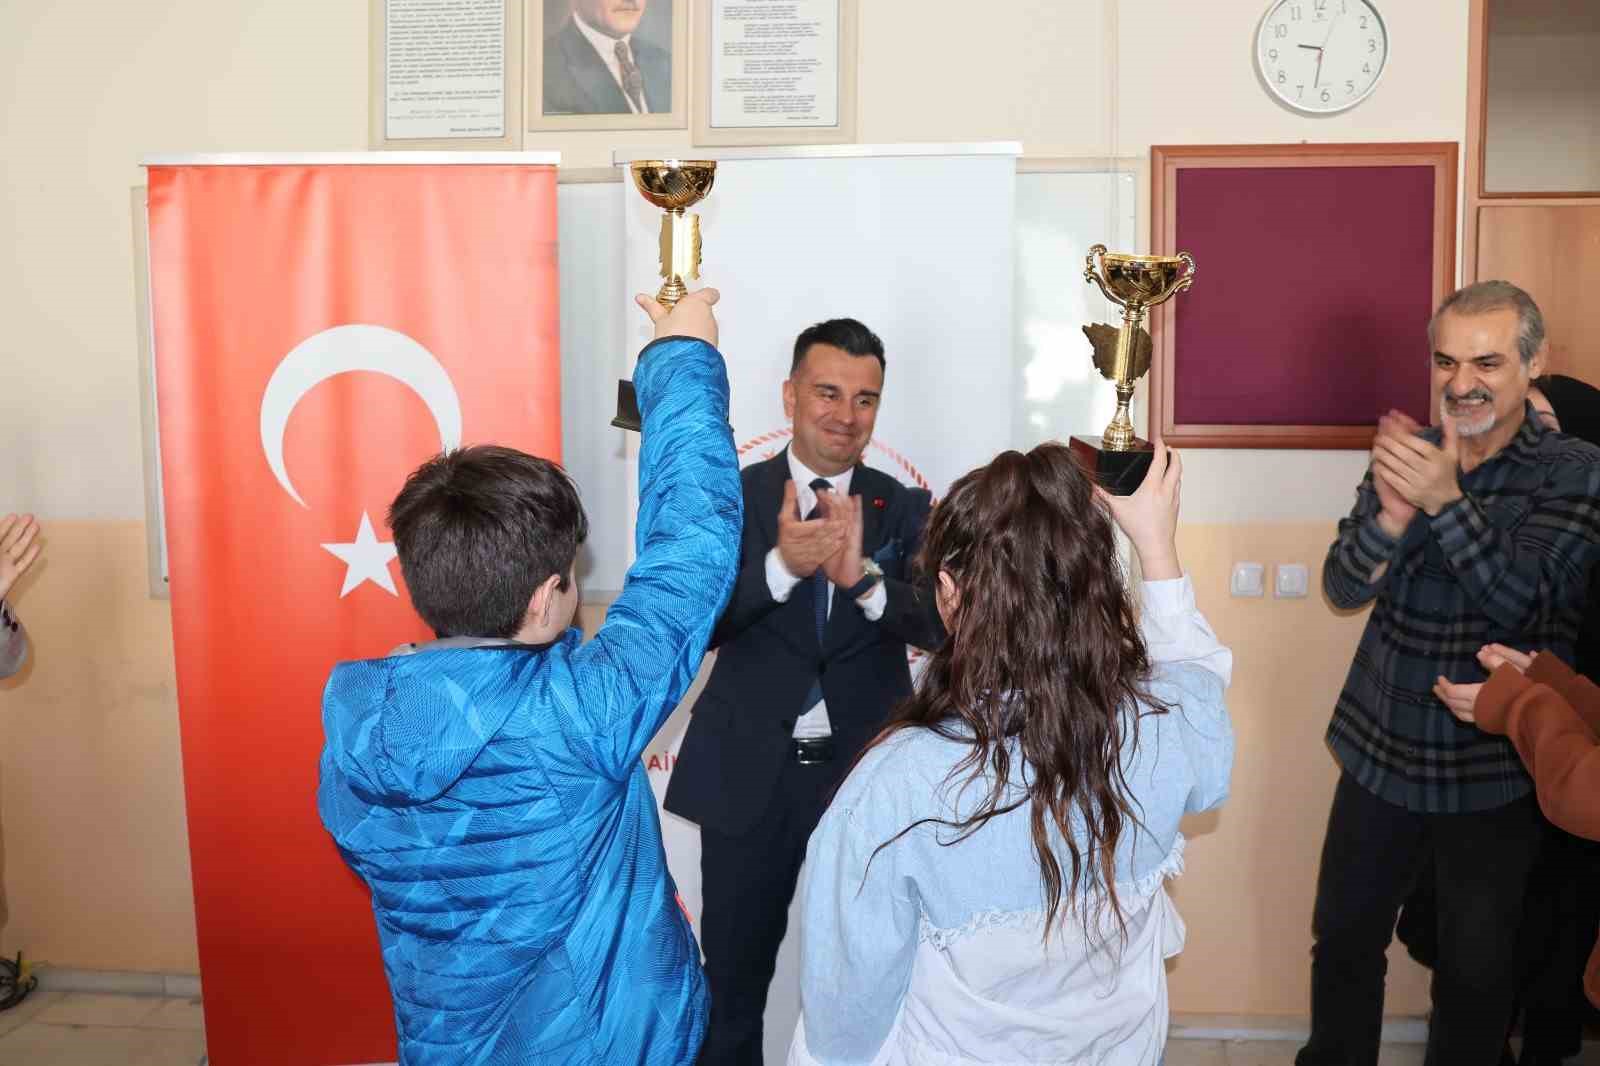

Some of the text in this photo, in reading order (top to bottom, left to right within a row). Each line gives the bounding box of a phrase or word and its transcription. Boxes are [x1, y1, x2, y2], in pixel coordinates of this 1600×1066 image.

[1313, 0, 1327, 10] 12
[1291, 6, 1302, 21] 11
[1359, 16, 1368, 29] 2
[1275, 23, 1288, 38] 10
[1368, 39, 1377, 53] 3
[1268, 48, 1278, 62] 9
[1362, 62, 1371, 74] 4
[1278, 70, 1287, 84] 8
[1296, 85, 1304, 99] 7
[1345, 80, 1355, 94] 5
[1320, 88, 1330, 102] 6
